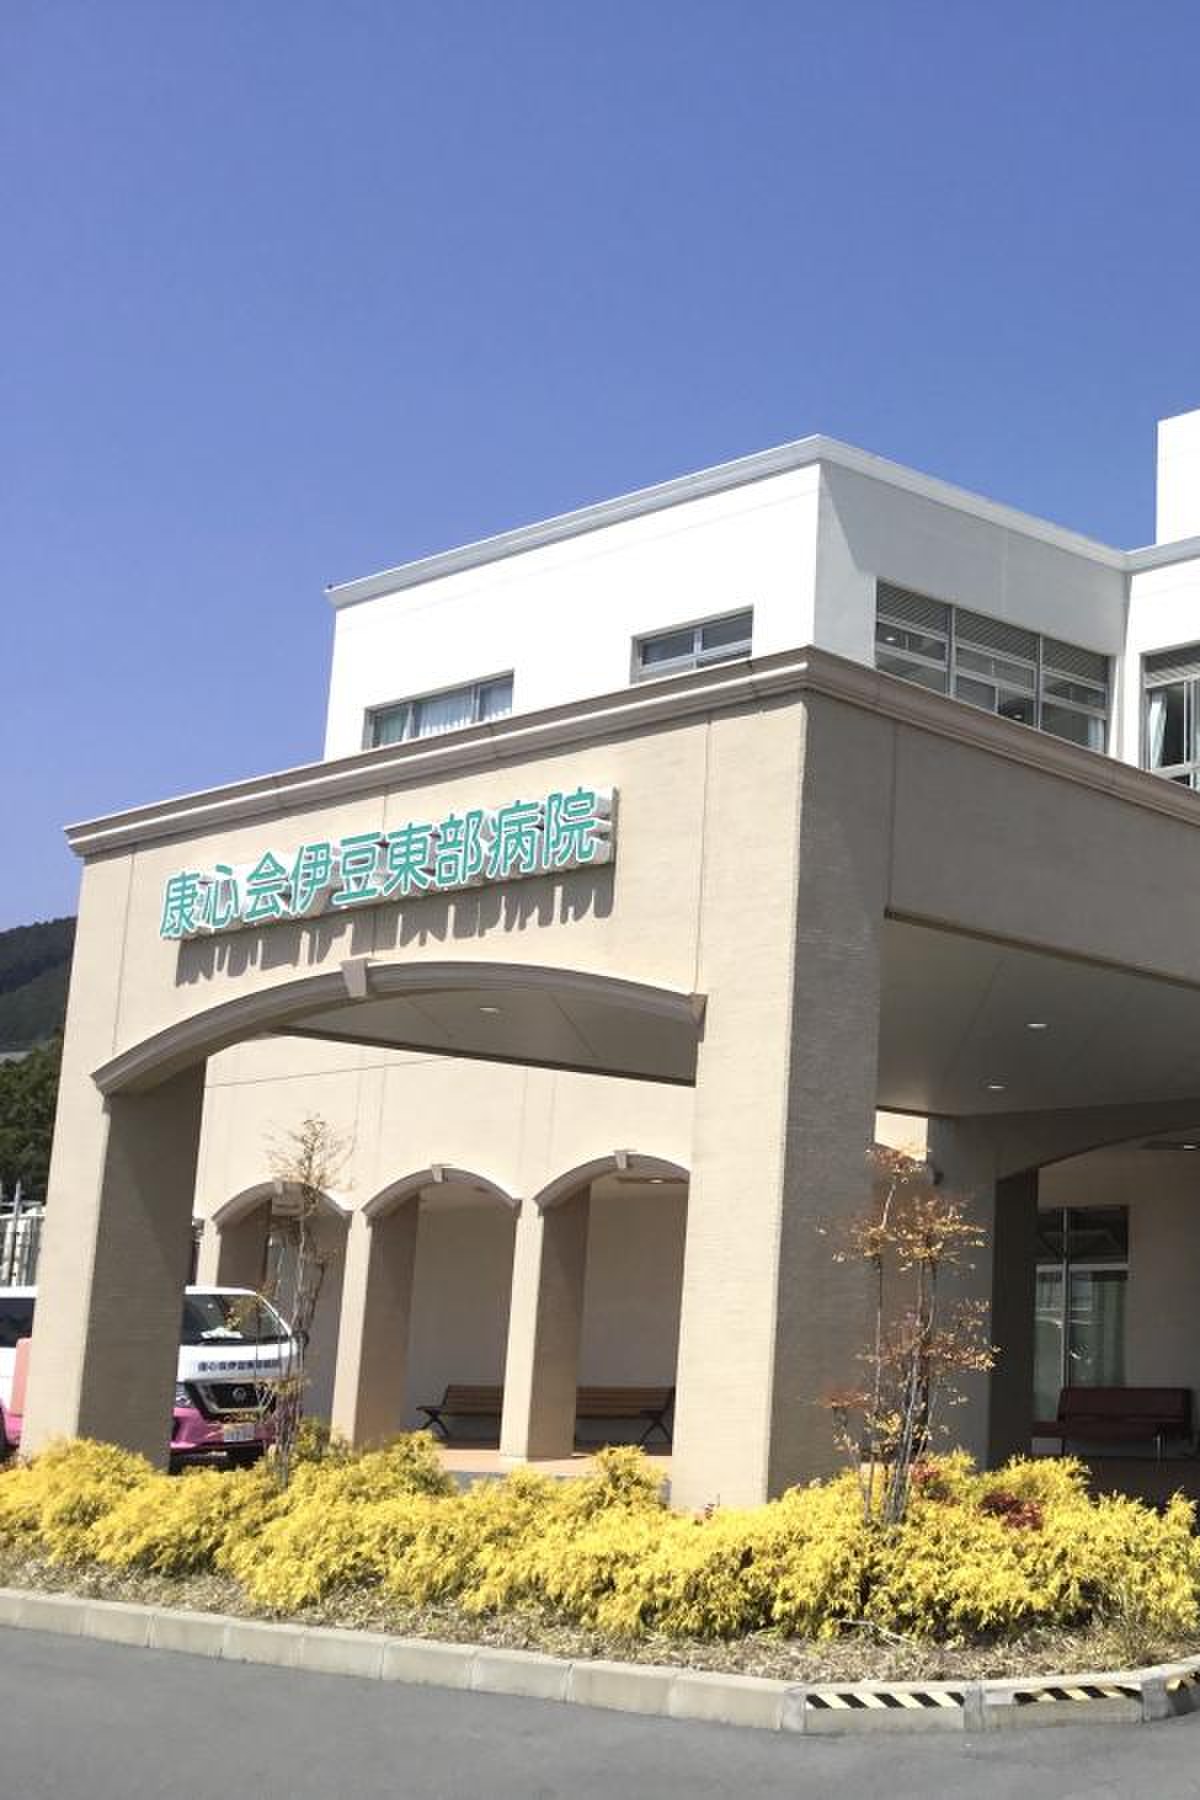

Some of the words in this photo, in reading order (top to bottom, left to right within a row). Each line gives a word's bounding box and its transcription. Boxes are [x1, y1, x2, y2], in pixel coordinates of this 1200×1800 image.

[160, 786, 599, 940] 康心会伊豆東部病院
